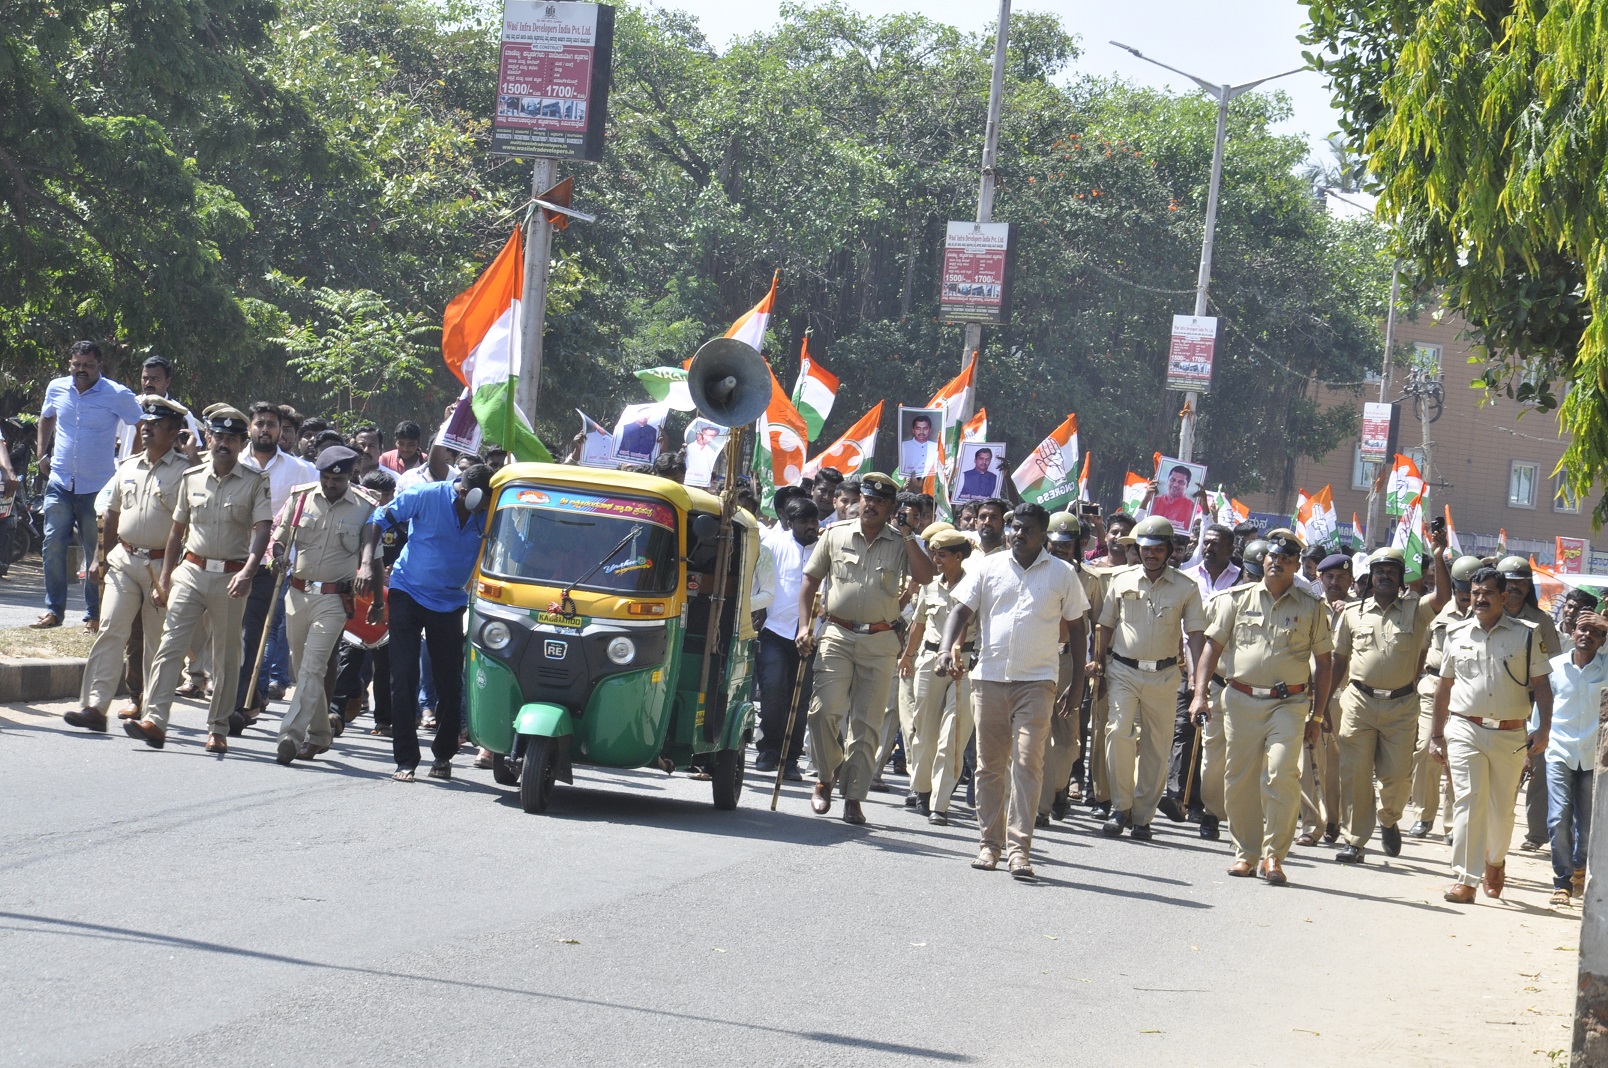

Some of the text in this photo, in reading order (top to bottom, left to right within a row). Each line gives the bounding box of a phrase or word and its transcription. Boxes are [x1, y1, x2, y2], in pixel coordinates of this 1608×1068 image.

[520, 22, 531, 32] Infra
[532, 23, 557, 35] Developers
[557, 25, 571, 34] India
[571, 25, 580, 34] Pvt.
[581, 26, 591, 35] Ltd.
[502, 83, 533, 94] 1500/-
[546, 85, 577, 97] 1700/-
[548, 646, 562, 656] RE
